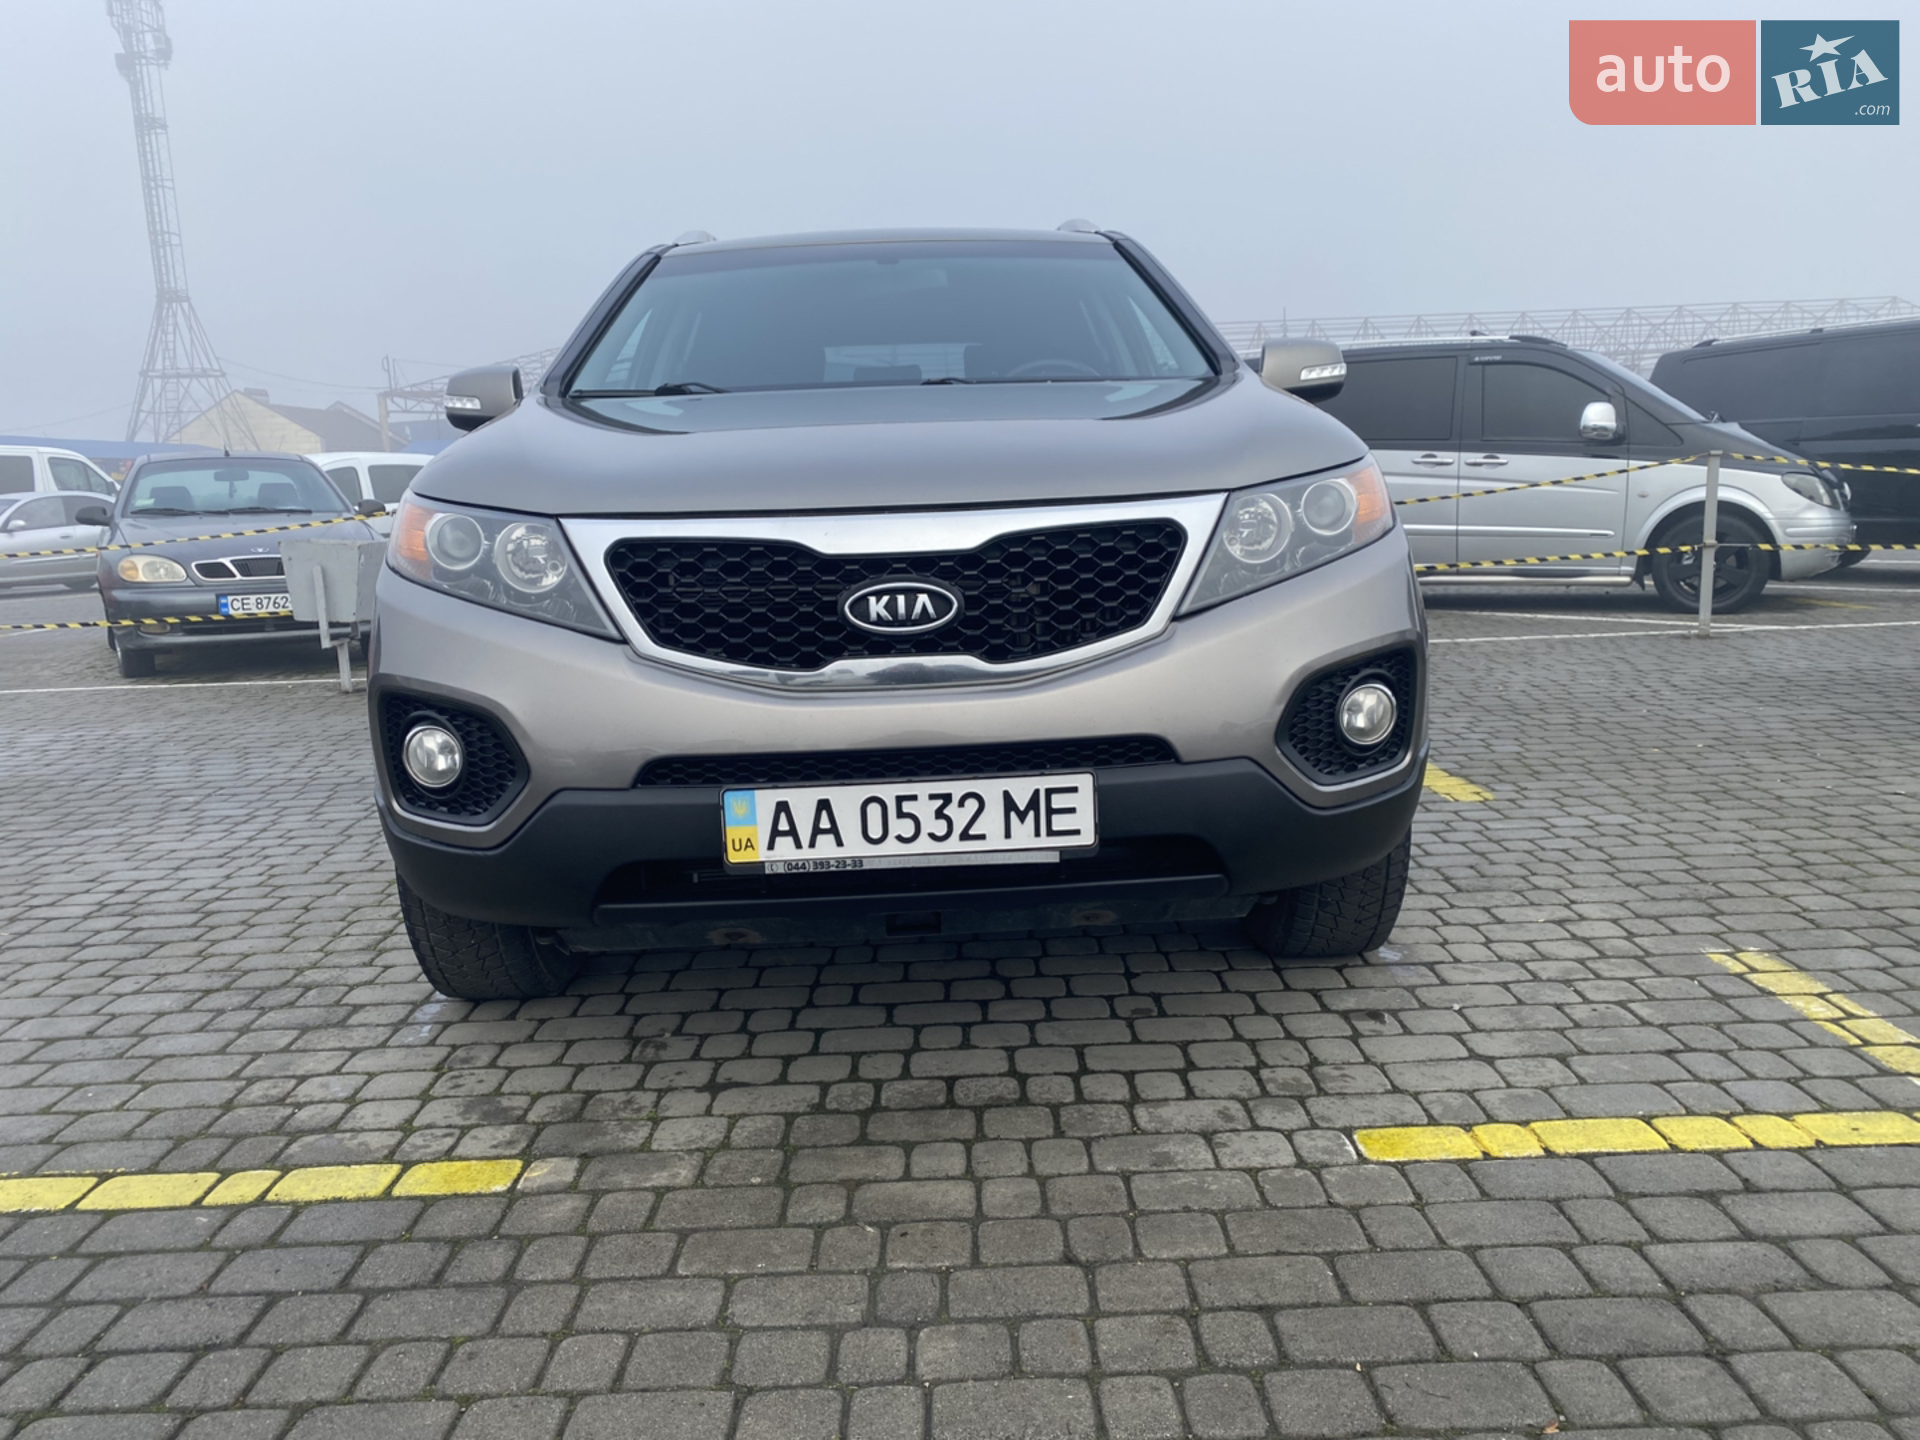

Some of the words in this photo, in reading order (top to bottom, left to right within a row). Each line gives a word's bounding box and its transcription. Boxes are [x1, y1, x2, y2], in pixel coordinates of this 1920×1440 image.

[230, 597, 252, 611] CE
[255, 595, 289, 610] 8762
[866, 593, 937, 621] KIA
[766, 798, 844, 851] AA
[860, 791, 987, 845] 0532
[1002, 786, 1081, 840] ME
[731, 837, 756, 852] UA
[783, 860, 811, 873] (044)
[812, 859, 864, 871] 393-23-33
